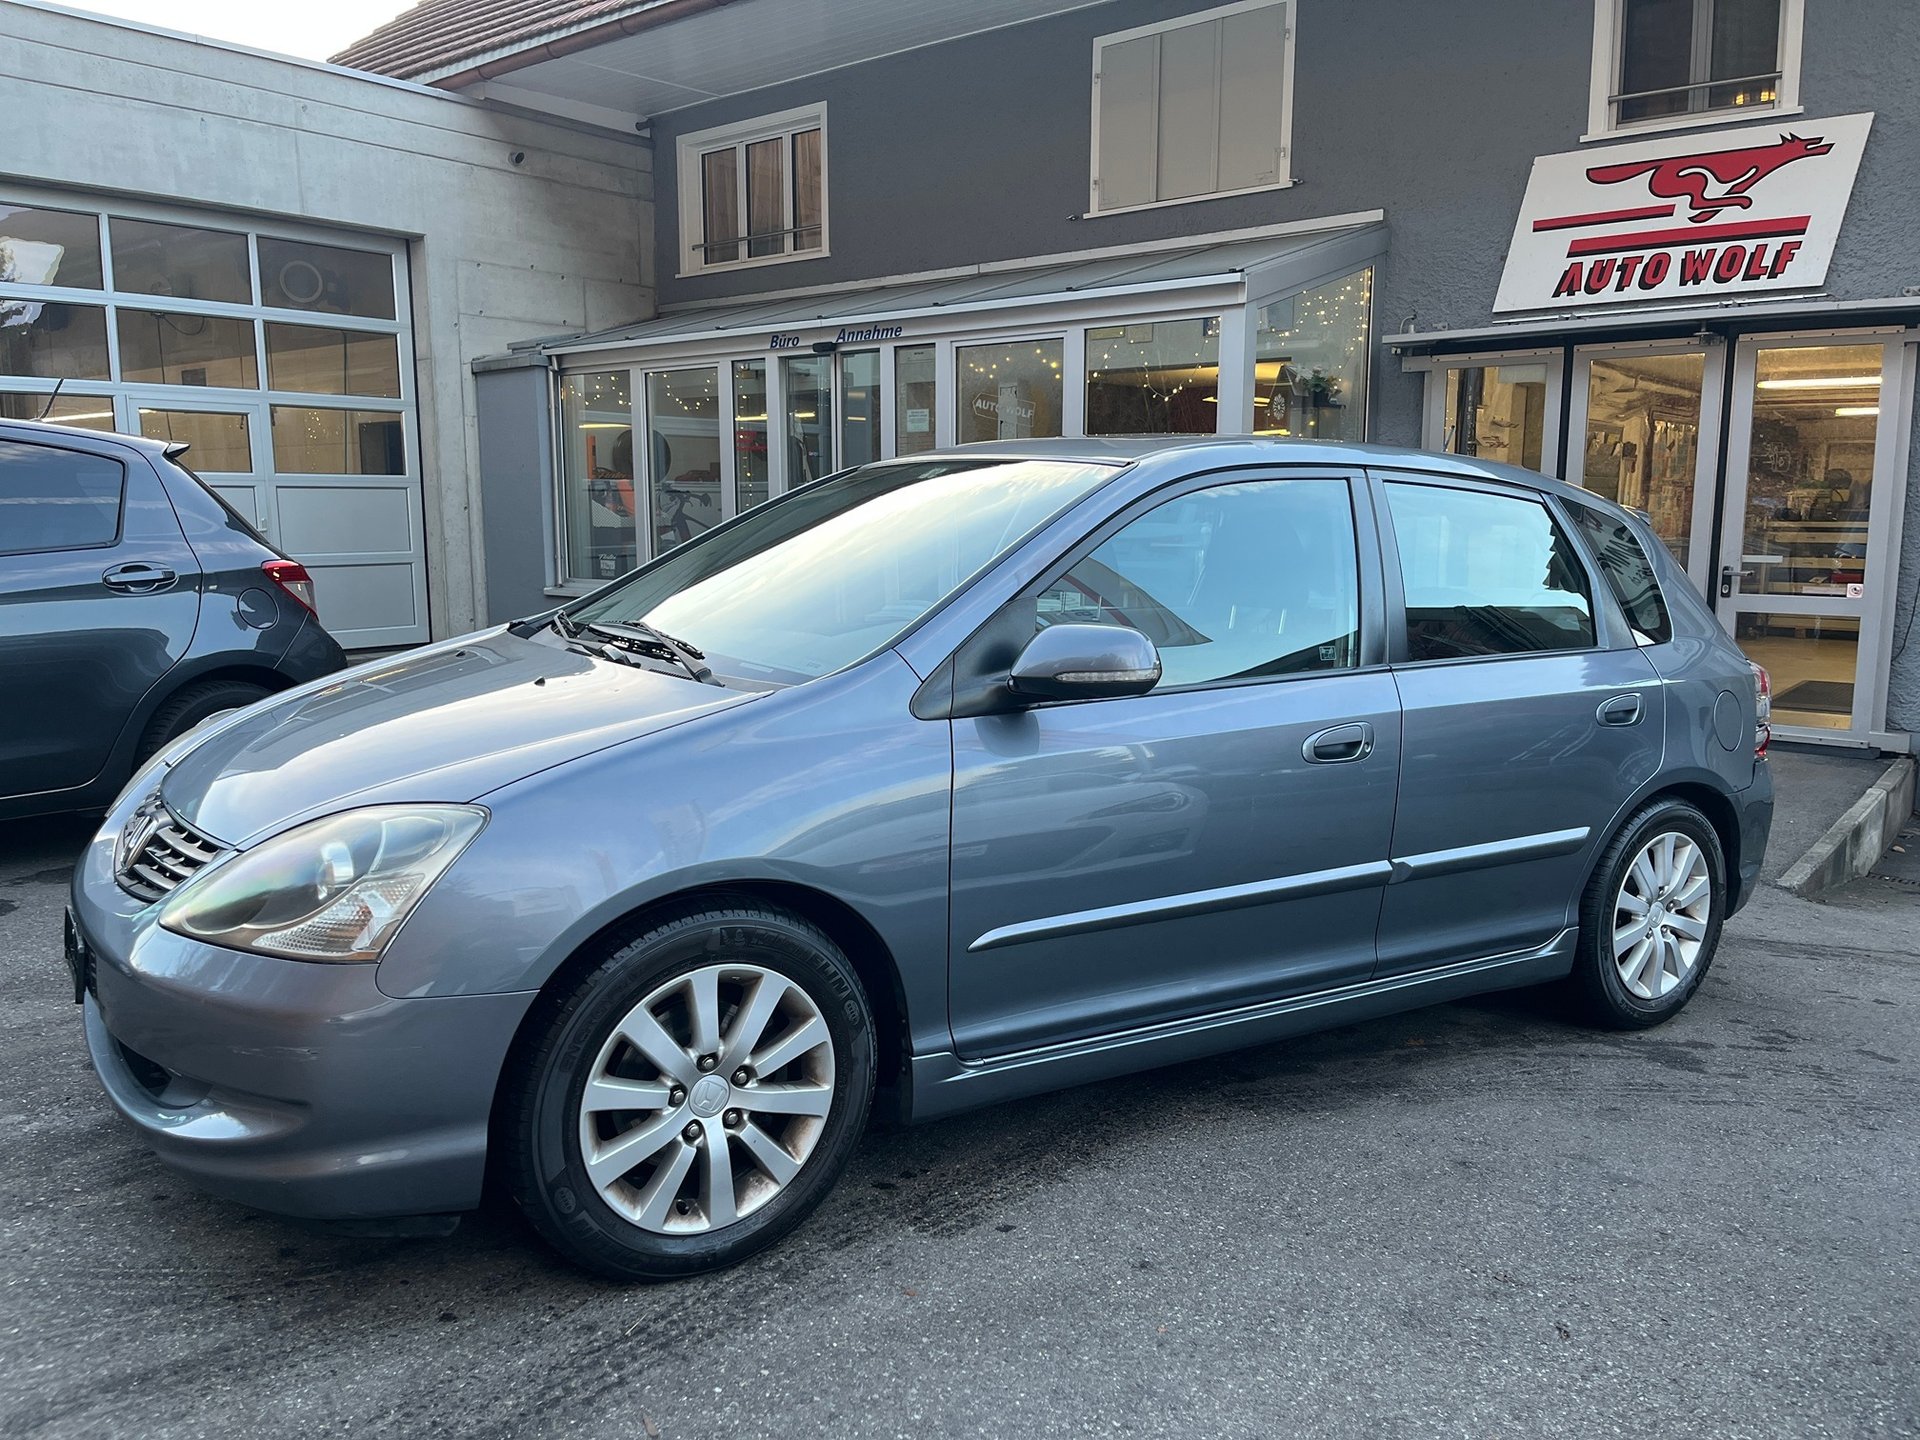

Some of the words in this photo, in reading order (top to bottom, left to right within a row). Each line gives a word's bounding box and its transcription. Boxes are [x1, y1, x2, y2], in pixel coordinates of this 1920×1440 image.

[1551, 252, 1671, 297] AUTO
[1678, 240, 1803, 287] WOLF
[770, 334, 800, 349] Büro
[836, 325, 903, 343] Annahme
